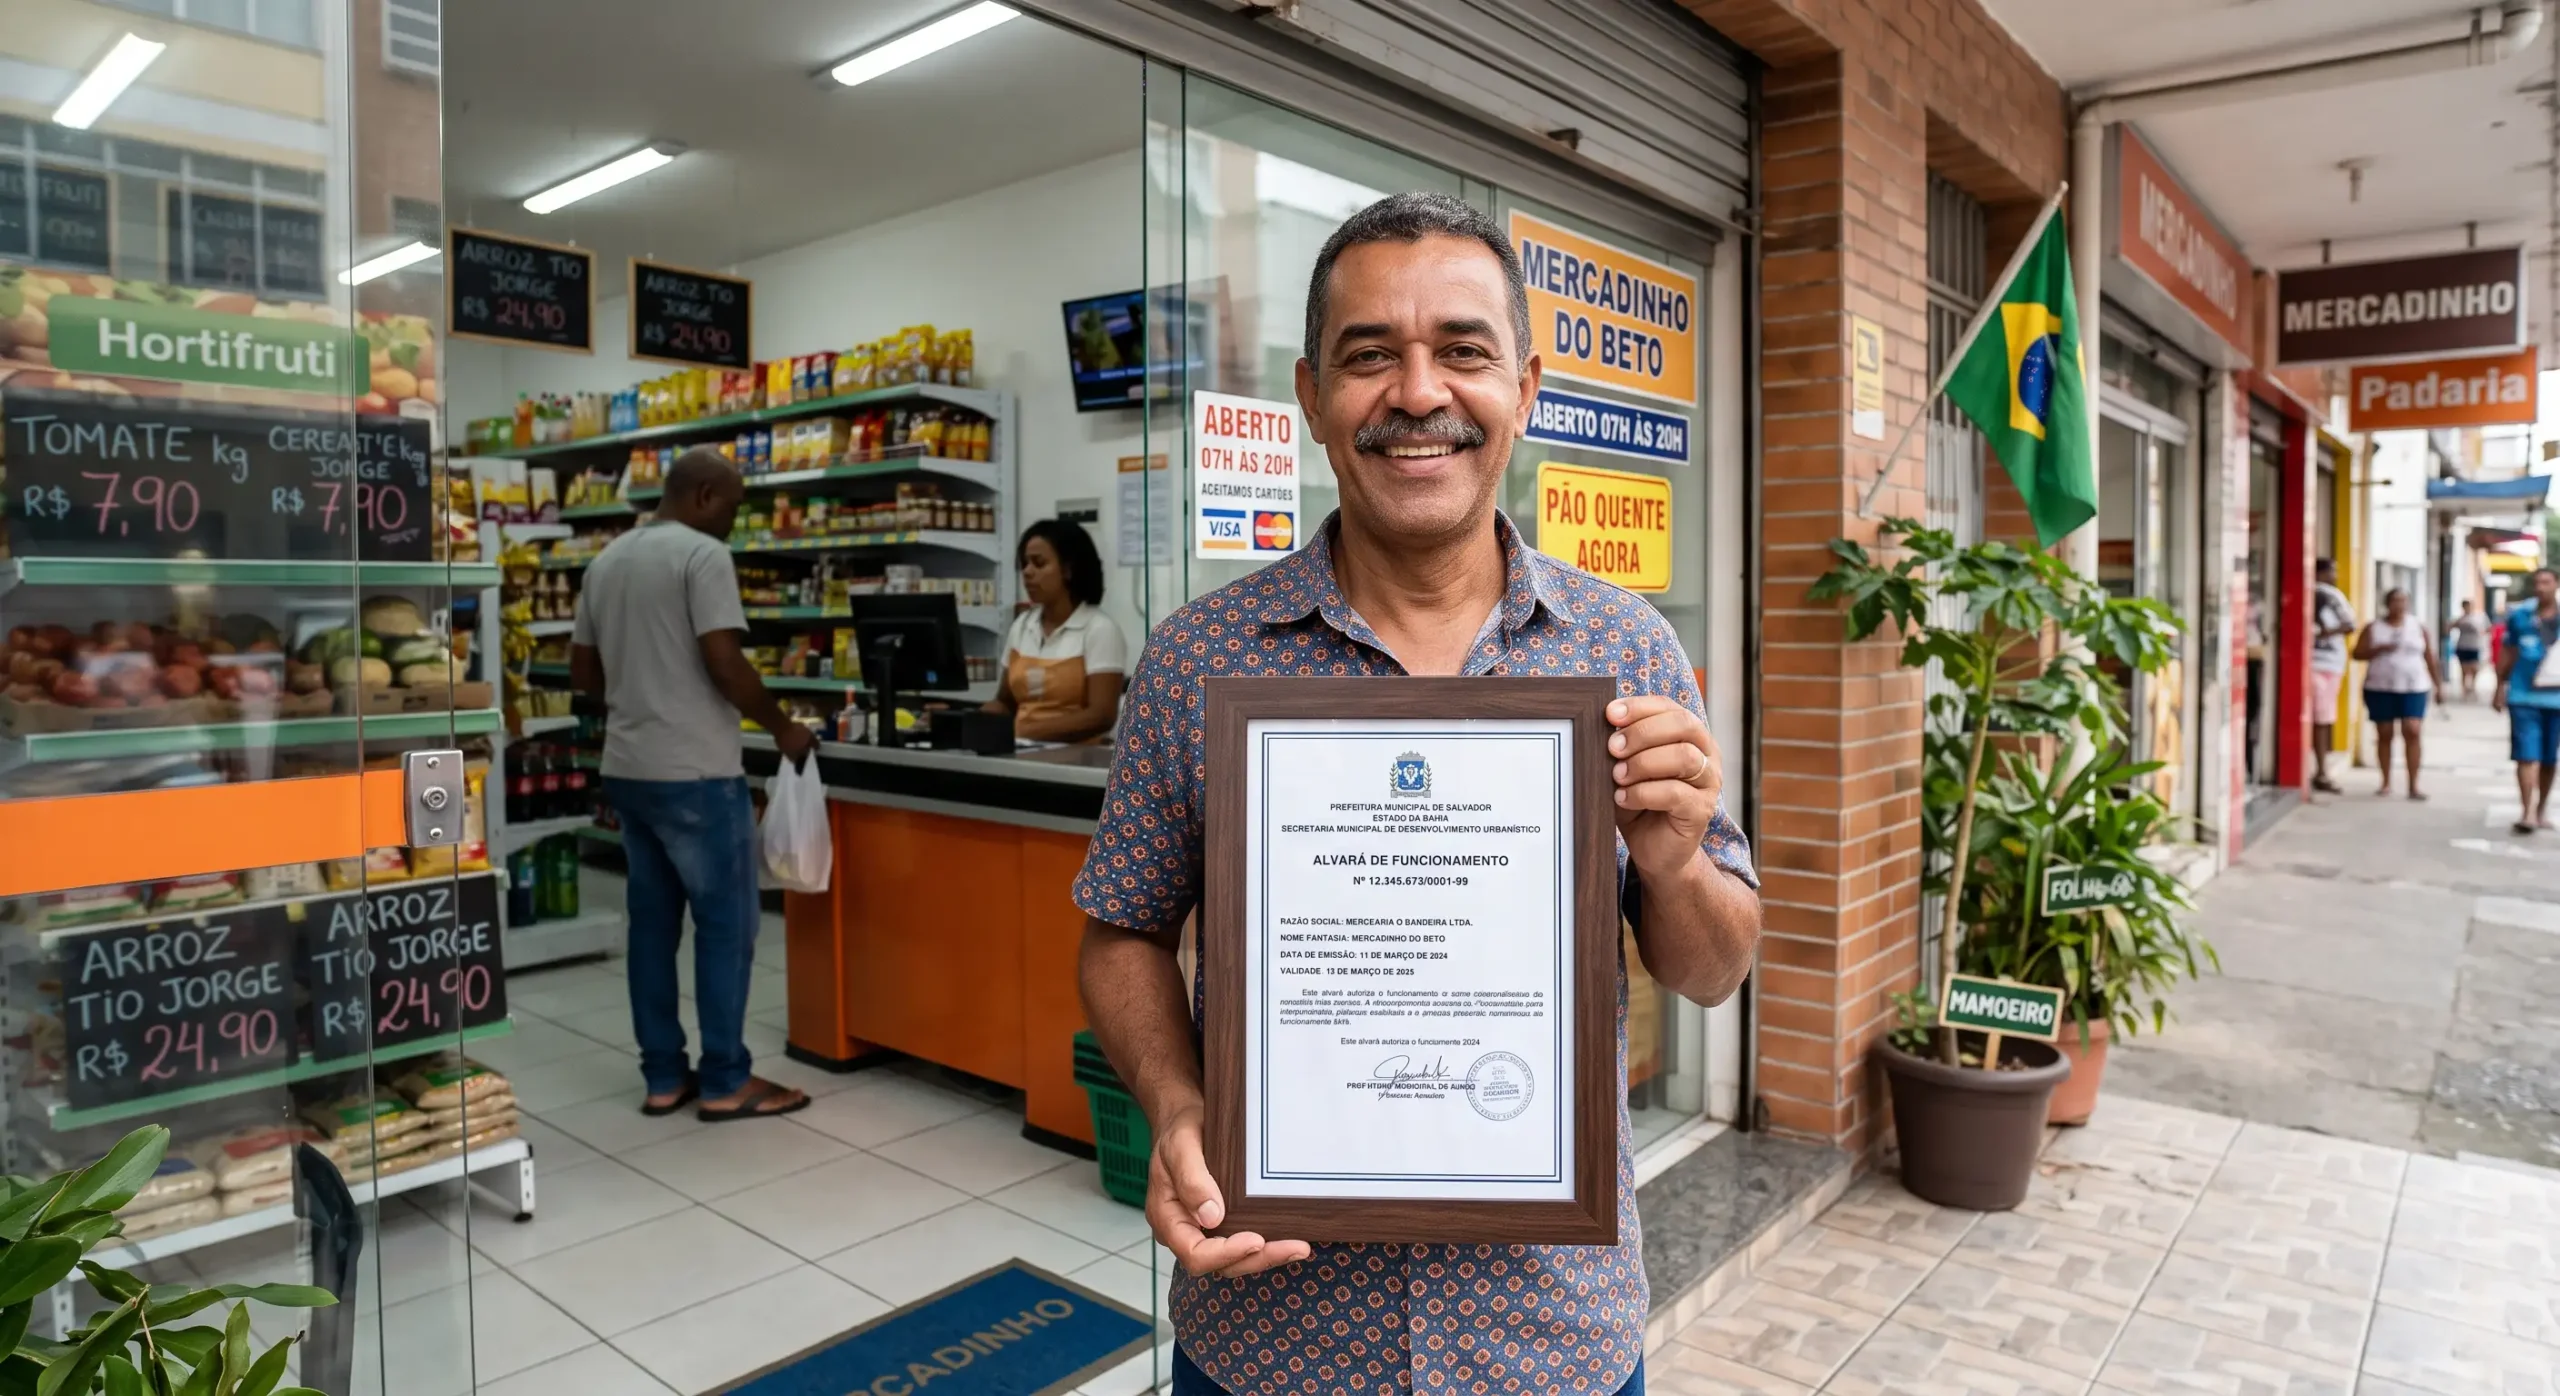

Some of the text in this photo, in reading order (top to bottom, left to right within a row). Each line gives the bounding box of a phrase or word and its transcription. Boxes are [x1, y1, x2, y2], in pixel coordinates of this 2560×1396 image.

[461, 239, 582, 279] ARROZ TIO
[2139, 171, 2237, 323] MERCADINHO
[490, 270, 557, 300] JORGE
[1522, 239, 1689, 333] MERCADINHO
[2284, 281, 2517, 333] MERCADINHO
[99, 318, 335, 378] Hortifruti
[1555, 311, 1663, 378] DO BETO
[2359, 367, 2529, 411] Padaria
[1203, 404, 1291, 444] ABERTO
[1530, 401, 1683, 452] ABERTO 07H ÀS 20H
[11, 415, 248, 483] TOMATE kg
[1201, 446, 1293, 476] 07H ÀS 20H
[23, 471, 199, 536] R$ 7,90
[272, 481, 407, 535] R$ 7,90
[1201, 483, 1293, 501] ACEITAMOS CARTÕES
[1546, 482, 1665, 531] PÃO QUENTE
[1209, 520, 1242, 537] VISA
[1577, 539, 1641, 574] AGORA
[1330, 803, 1492, 812] PREFEITURA MUNICIPAL DE SALVADOR
[1372, 814, 1449, 822] ESTADO DA BAHIA
[1281, 824, 1540, 834] SECRETARIA MUNICIPAL DE DESENVOLVIMENTO URBANÍSTICO
[1313, 852, 1508, 866] ALVARÁ DE FUNCIONAMENTO
[1369, 876, 1468, 886] 12.345.673/0001-99
[327, 888, 455, 942] ARROZ
[1311, 918, 1344, 926] SOCIAL:
[1346, 918, 1394, 926] MERCEARIA
[1405, 918, 1447, 926] BANDEIRA
[1449, 918, 1473, 926] LTDA.
[80, 925, 237, 984] ARROZ
[388, 921, 493, 971] JORGE
[1280, 934, 1446, 943] NOME FANTASIA: MERCADINHO DO BETO
[1280, 950, 1302, 958] DATA
[1304, 950, 1316, 959] DE
[1370, 951, 1382, 959] DE
[1384, 952, 1414, 961] MARÇO
[1416, 952, 1428, 960] DE
[1430, 952, 1448, 960] 2024
[158, 962, 283, 1015] JORGE
[1327, 967, 1335, 975] 13
[1337, 967, 1348, 975] DE
[1350, 968, 1381, 977] MARÇO
[1383, 968, 1394, 976] DE
[1396, 968, 1414, 976] 2025
[323, 964, 493, 1037] R$ 24,90
[1302, 988, 1318, 997] Este
[1347, 989, 1375, 997] autoriza
[1386, 989, 1438, 997] funcionamento
[1949, 990, 2054, 1026] MAMOEIRO
[76, 1009, 279, 1082] R$ 24,90
[1340, 1037, 1357, 1045] Este
[1381, 1038, 1410, 1046] autoriza
[1462, 1038, 1480, 1046] 2024
